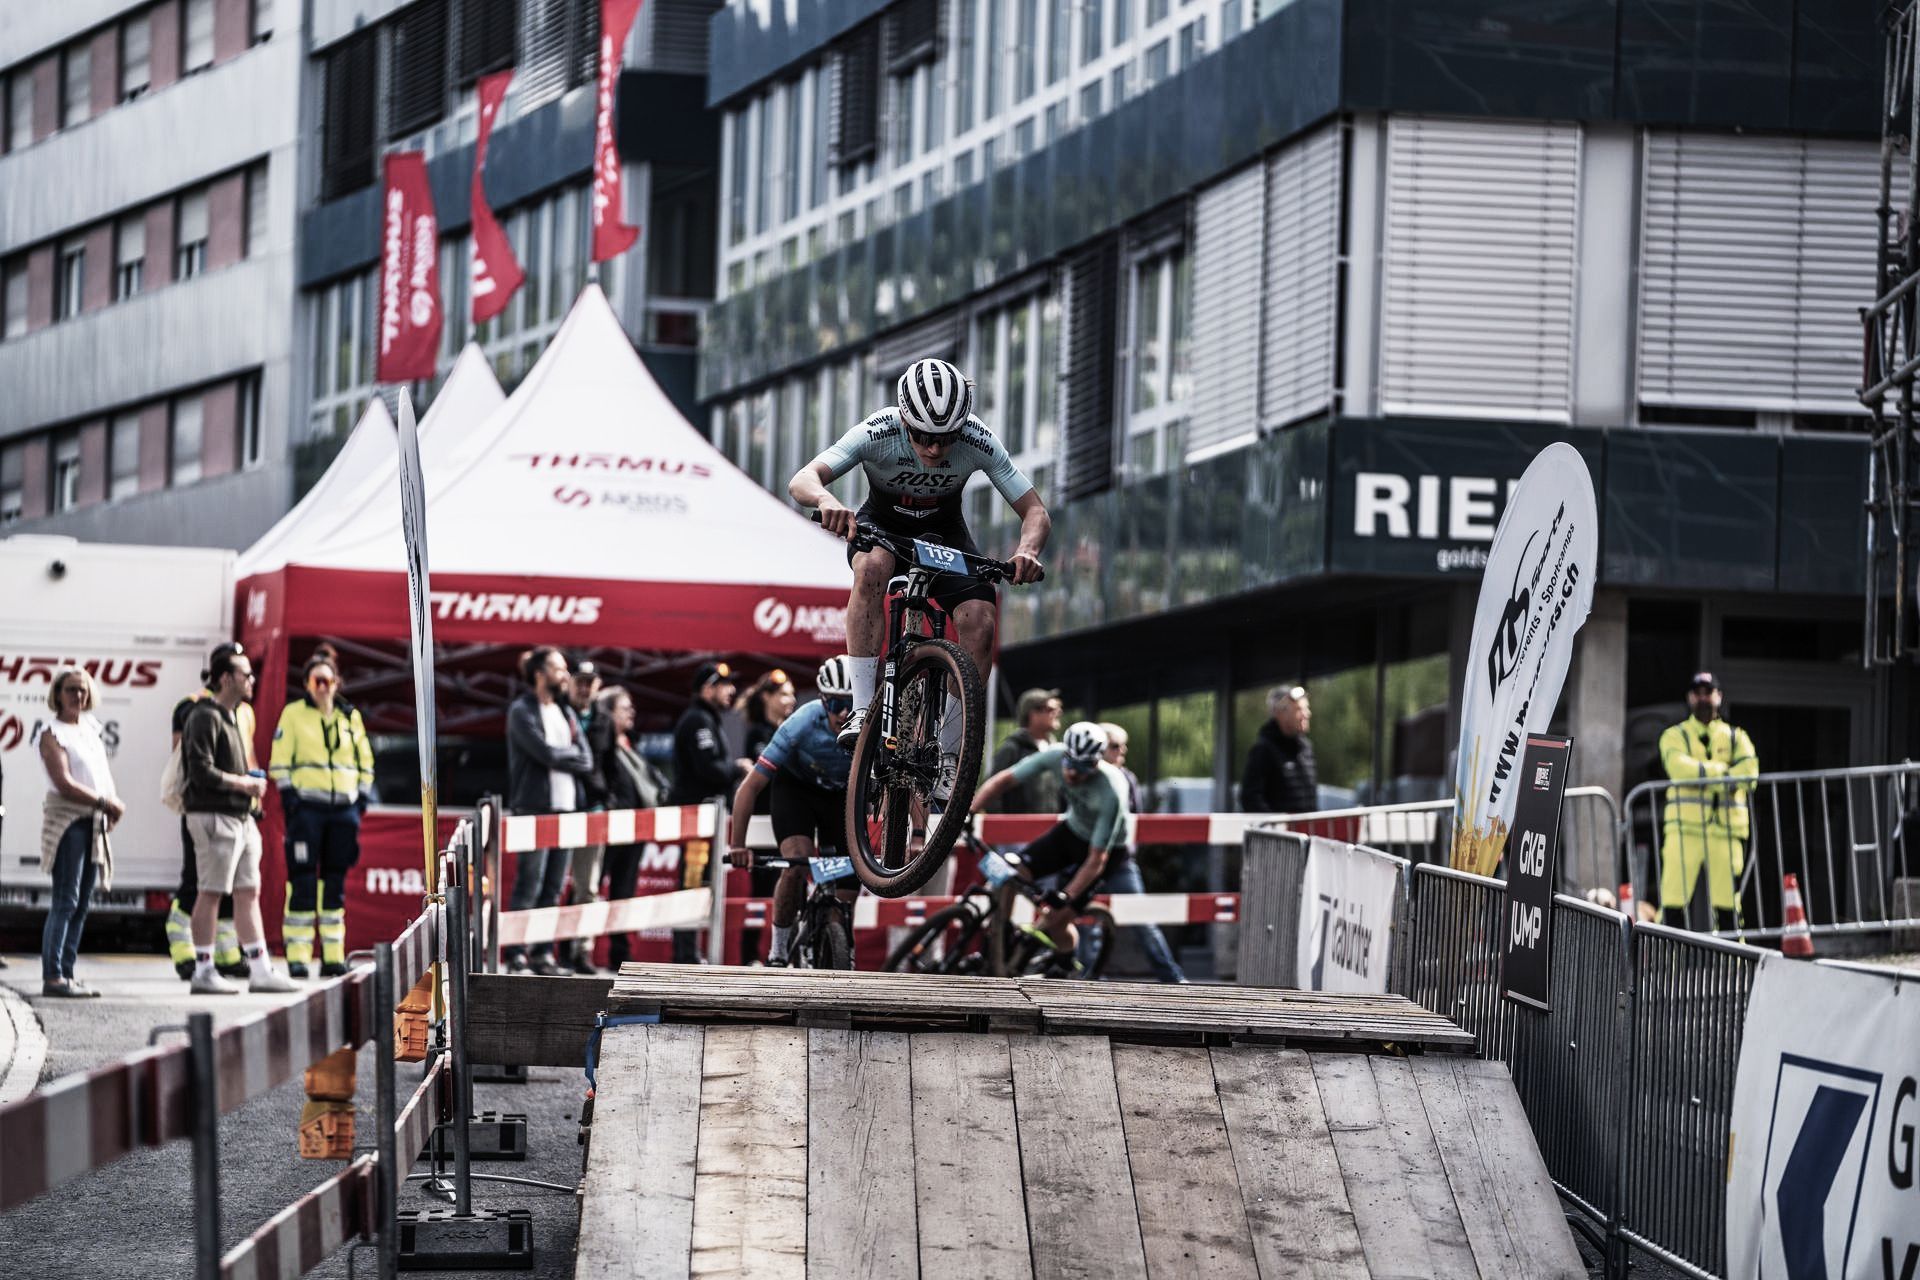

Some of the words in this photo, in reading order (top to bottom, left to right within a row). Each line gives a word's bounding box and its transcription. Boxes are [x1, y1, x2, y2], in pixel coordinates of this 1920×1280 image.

[889, 471, 959, 488] ROSE
[924, 546, 955, 562] 119
[1437, 546, 1491, 571] golds
[1541, 522, 1577, 604] Sportcamps
[1519, 829, 1547, 878] GKB
[1509, 900, 1542, 954] JUMP
